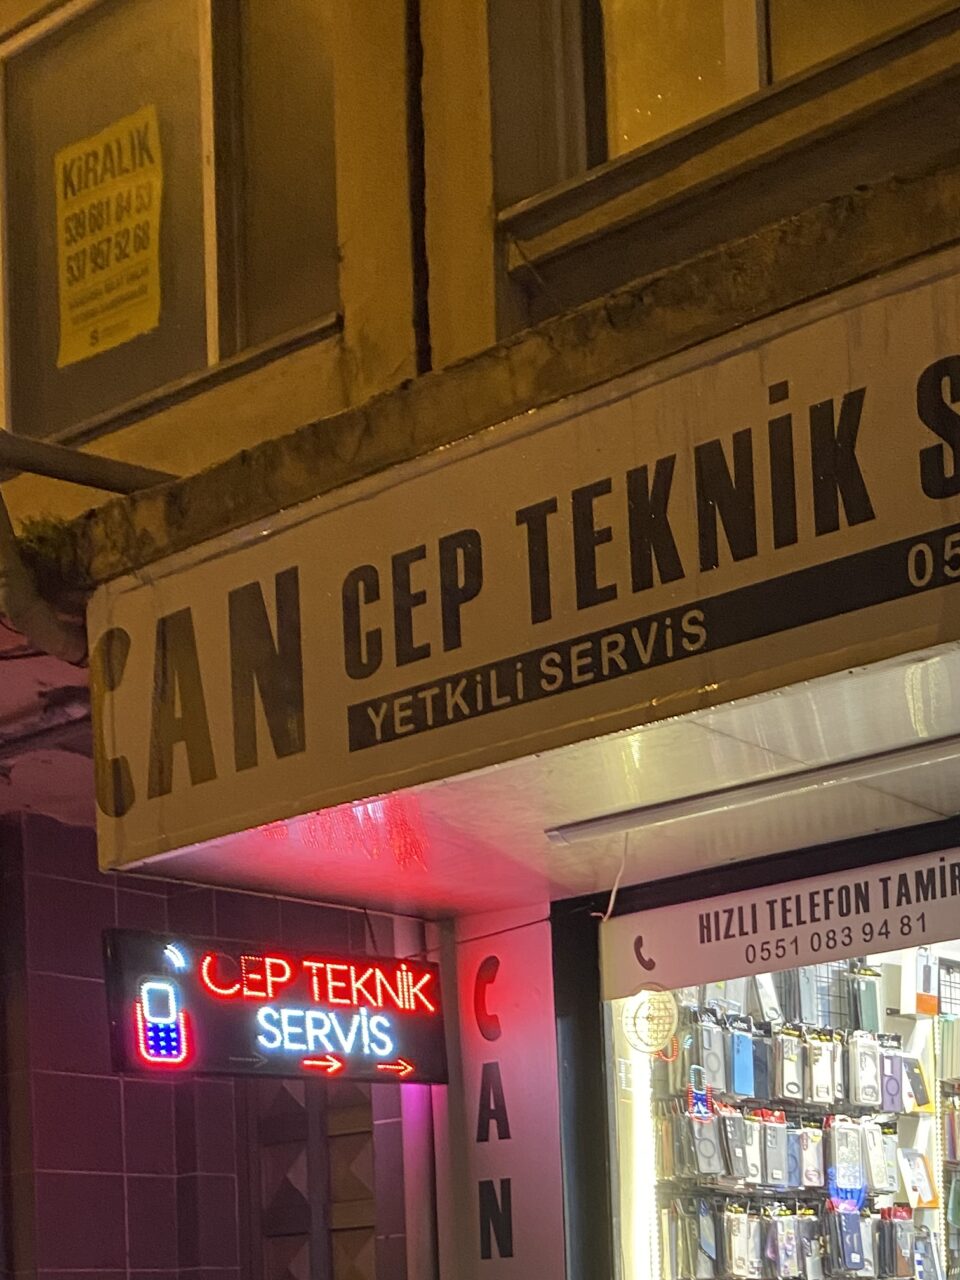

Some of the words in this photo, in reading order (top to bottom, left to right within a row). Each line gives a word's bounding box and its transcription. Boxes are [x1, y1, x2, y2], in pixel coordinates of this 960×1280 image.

[91, 566, 306, 818] CAN
[342, 529, 484, 680] CEP
[515, 380, 876, 625] TEKNİK
[699, 903, 758, 944] HIZLI
[766, 881, 871, 931] TELEFON
[745, 935, 800, 965] 0551
[810, 926, 853, 953] 083
[862, 919, 891, 943] 94
[899, 912, 927, 936] 81
[202, 953, 291, 997] CEP
[303, 963, 435, 1012] TEKNİK
[256, 1006, 394, 1056] SERVİS
